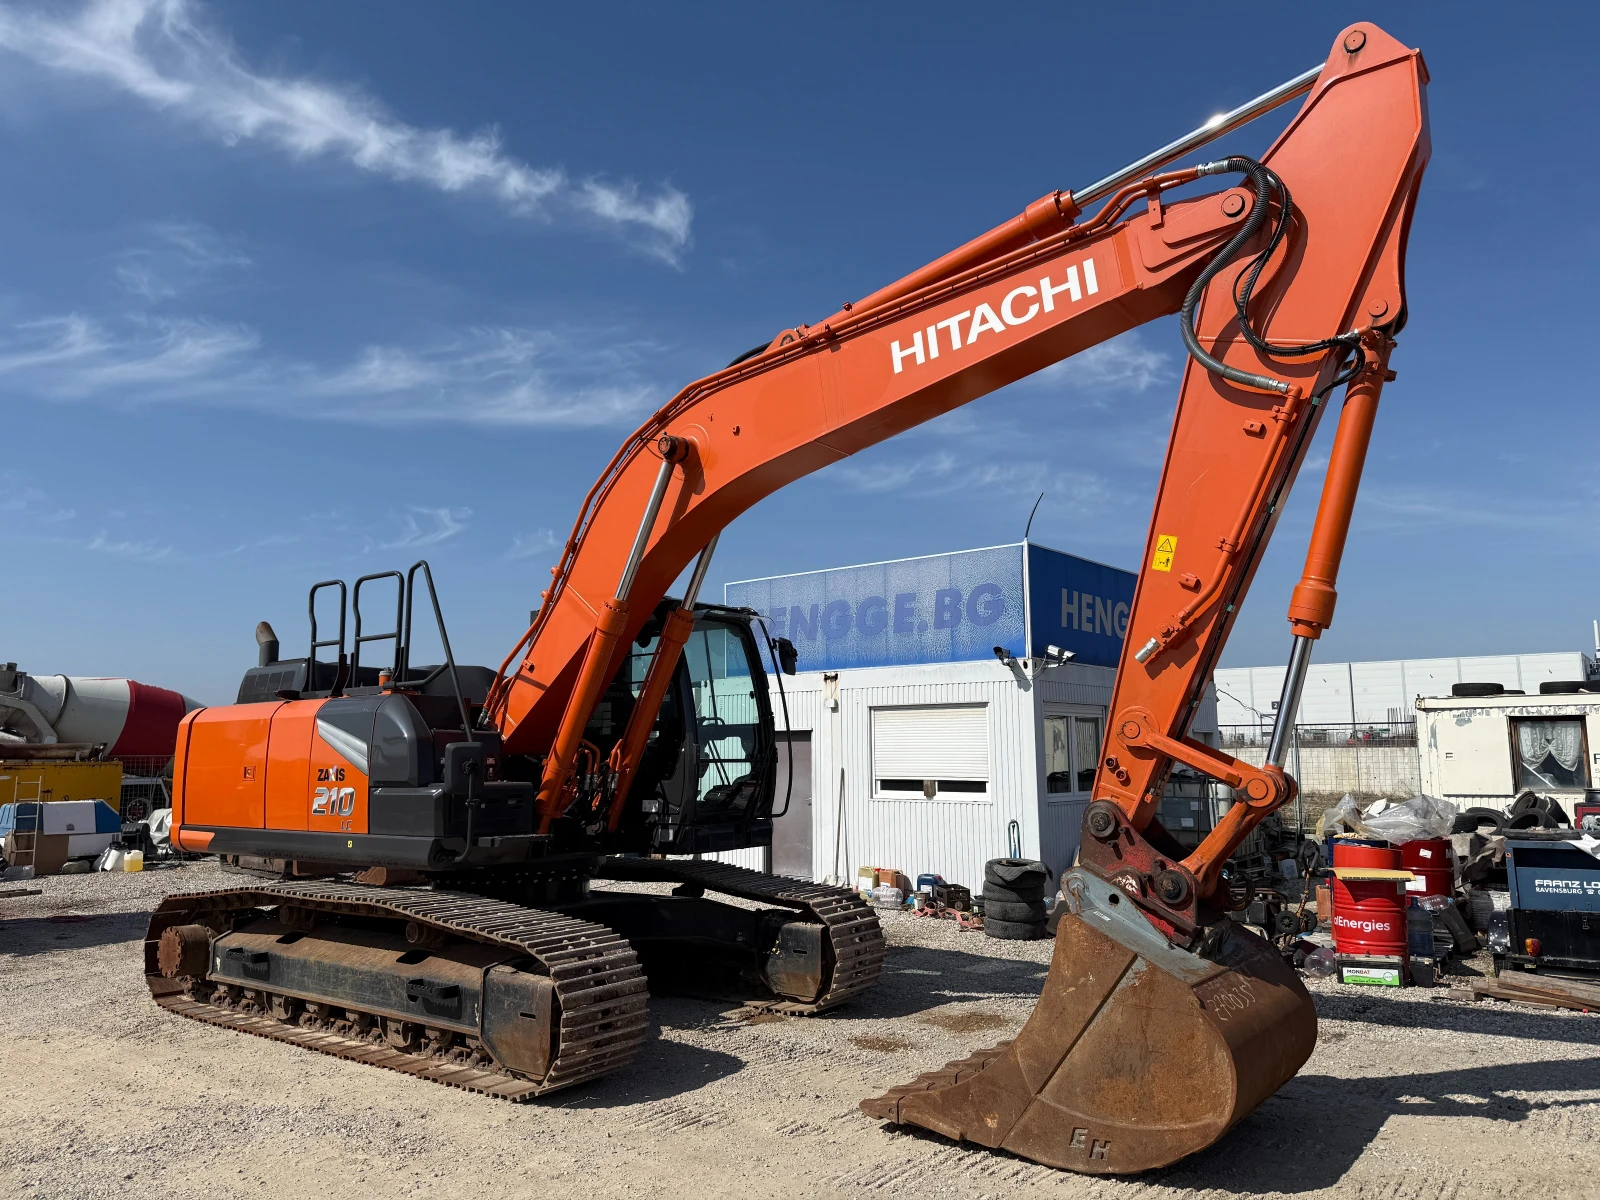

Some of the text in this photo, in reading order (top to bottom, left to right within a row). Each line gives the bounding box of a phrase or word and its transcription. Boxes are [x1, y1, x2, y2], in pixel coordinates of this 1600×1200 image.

[890, 257, 1099, 375] HITACHI
[1061, 587, 1129, 640] HENG
[317, 765, 346, 782] ZAXIS
[311, 786, 356, 816] 210
[1534, 879, 1581, 888] FRANZ
[1535, 887, 1583, 895] RAVENSBURG
